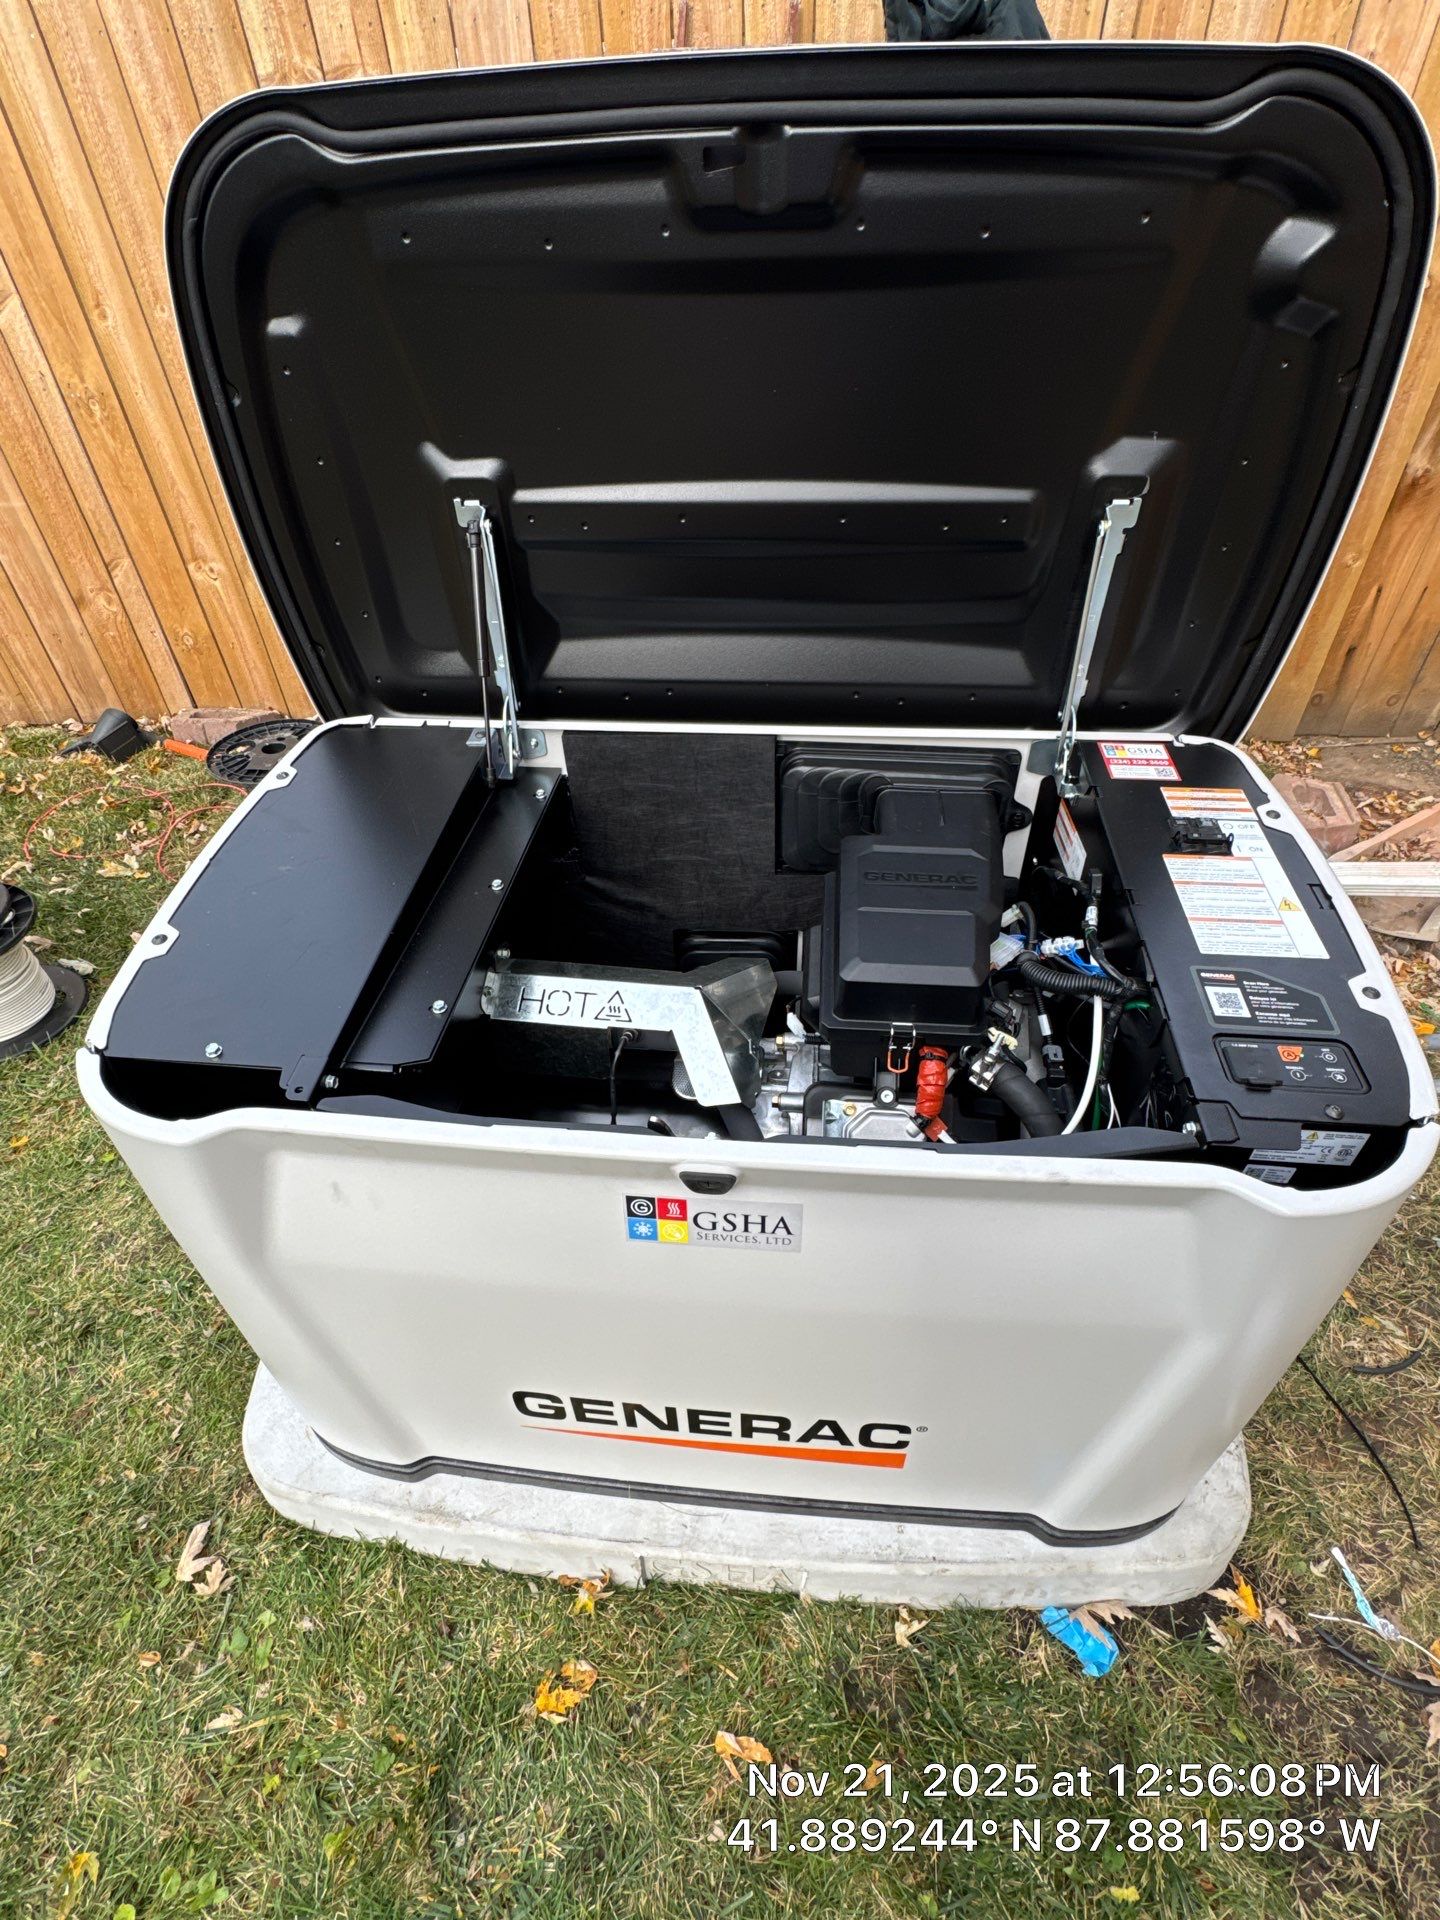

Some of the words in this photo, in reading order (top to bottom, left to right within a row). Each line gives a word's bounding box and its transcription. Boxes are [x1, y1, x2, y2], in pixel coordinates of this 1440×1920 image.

[863, 871, 978, 885] GENERAC
[517, 986, 598, 1018] HOT
[692, 1211, 795, 1236] GSHA
[765, 1236, 792, 1246] LTD
